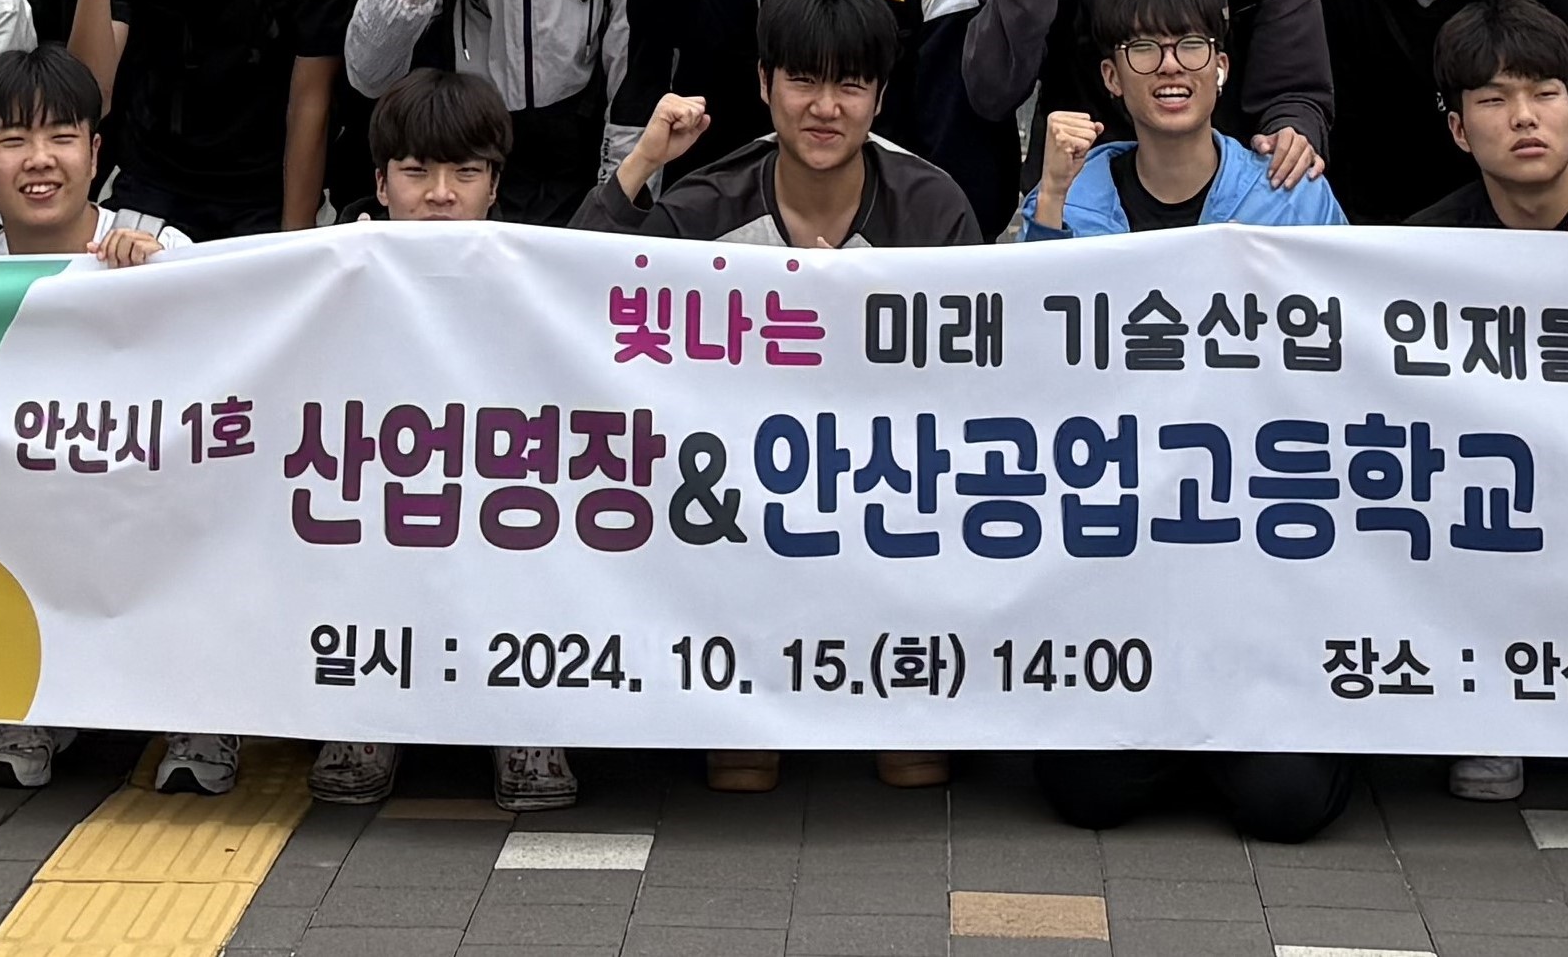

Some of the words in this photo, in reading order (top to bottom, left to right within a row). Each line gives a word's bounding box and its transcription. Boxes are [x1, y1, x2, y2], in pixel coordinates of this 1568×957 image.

[609, 285, 827, 367] 빛나는
[865, 292, 1003, 369] 미래
[1043, 290, 1342, 372] 기술산업
[14, 399, 163, 474] 안산시
[181, 395, 255, 464] 1호
[310, 624, 413, 690] 일시
[487, 632, 642, 693] 2024.
[671, 635, 753, 695] 10.
[993, 638, 1153, 693] 14:00
[1322, 637, 1435, 700] 장소
